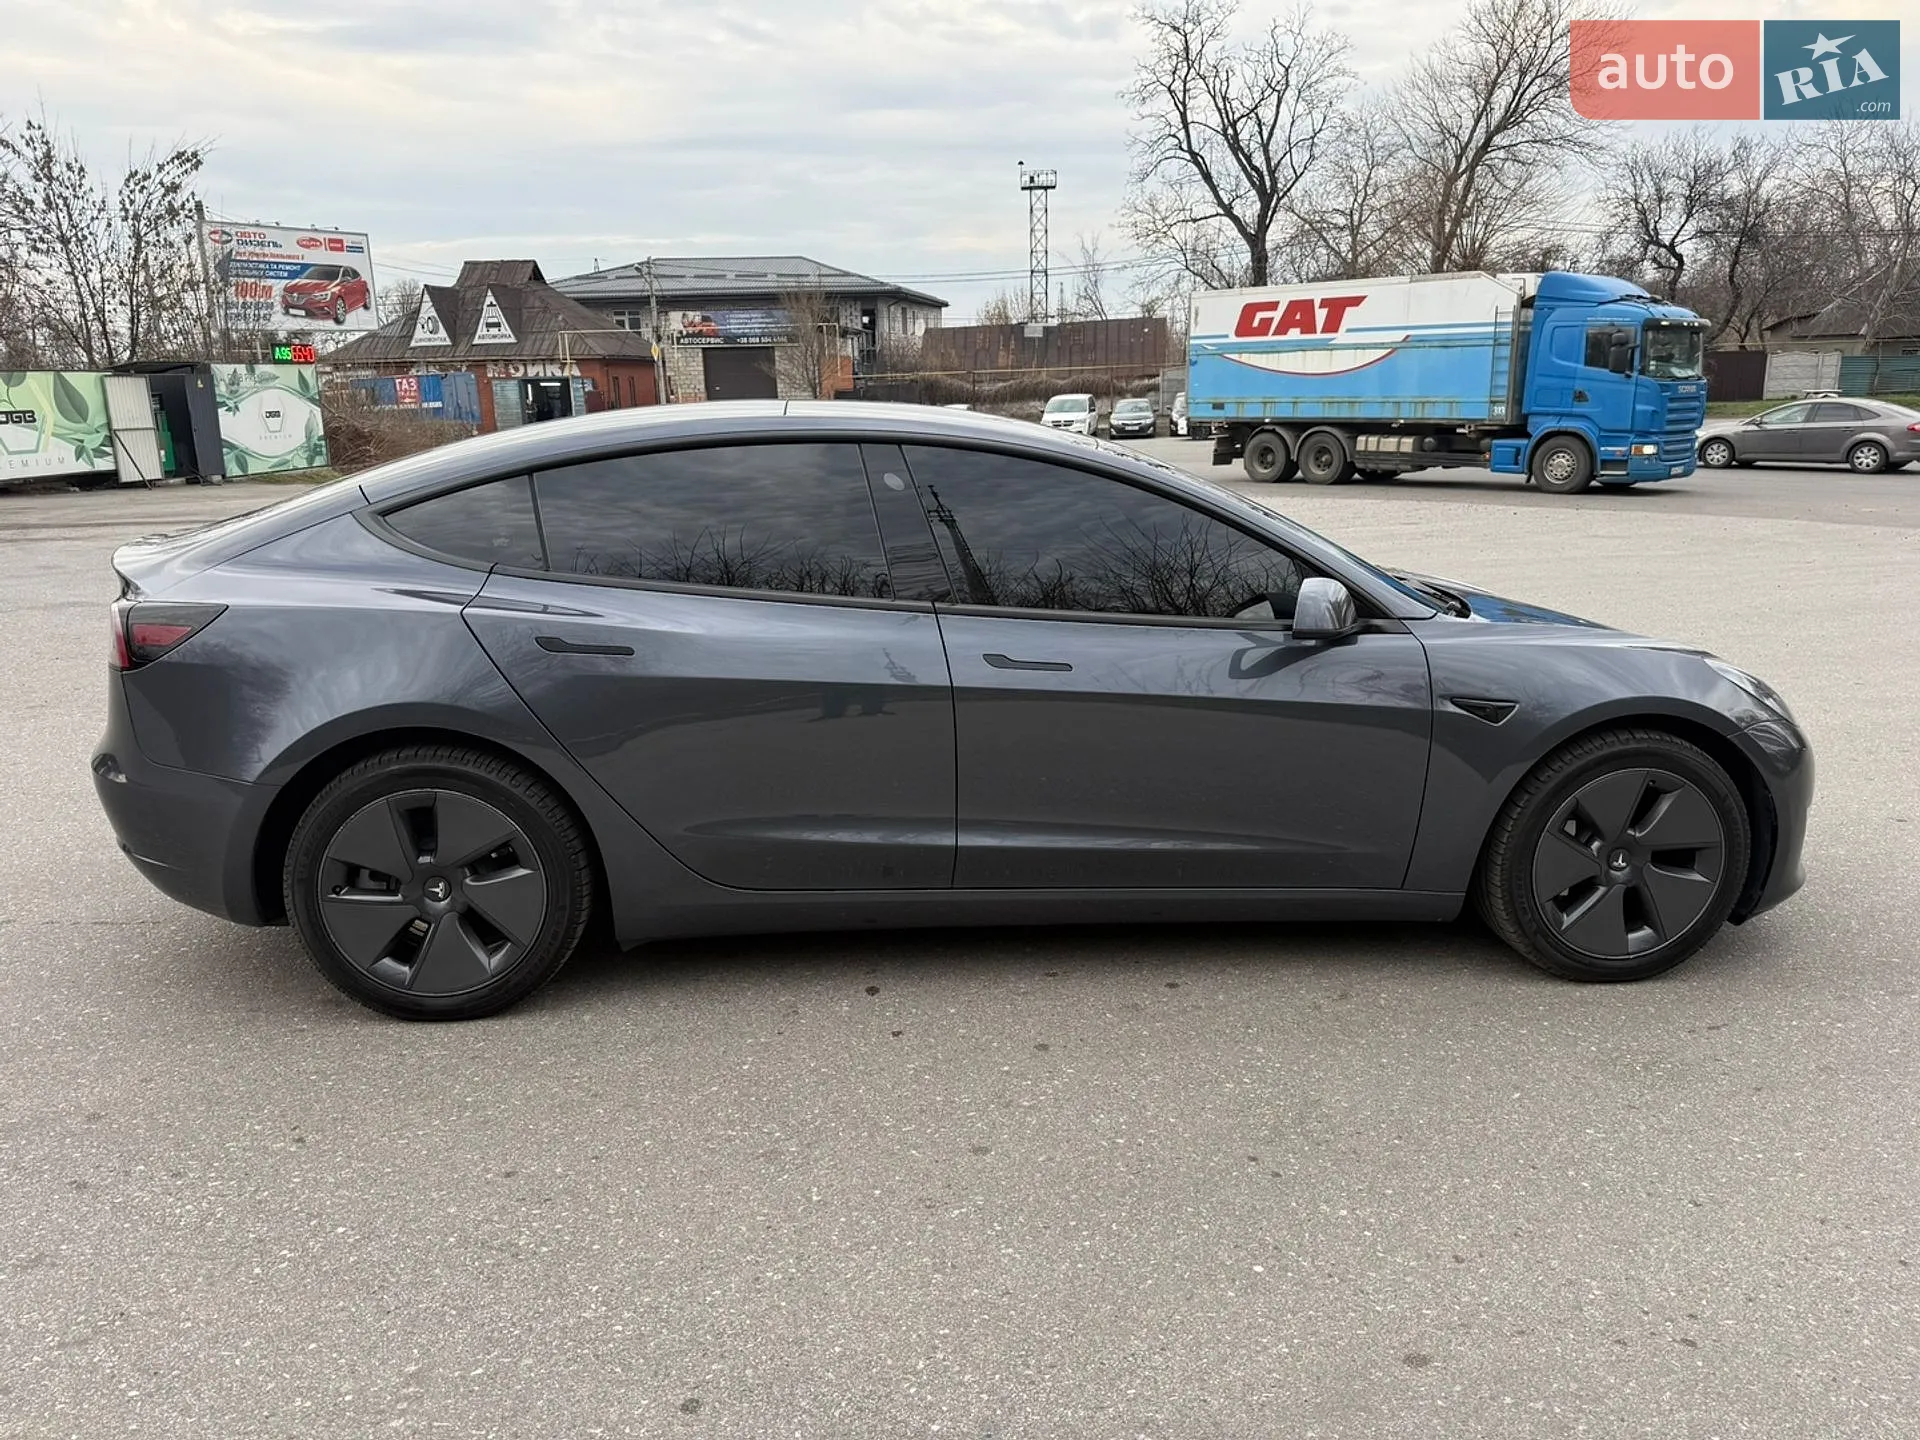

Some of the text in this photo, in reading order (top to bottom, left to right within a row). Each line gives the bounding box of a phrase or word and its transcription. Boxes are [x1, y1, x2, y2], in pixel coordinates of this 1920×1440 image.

[1234, 294, 1369, 338] GAT
[275, 346, 292, 360] A95
[395, 378, 417, 391] ГАЗ
